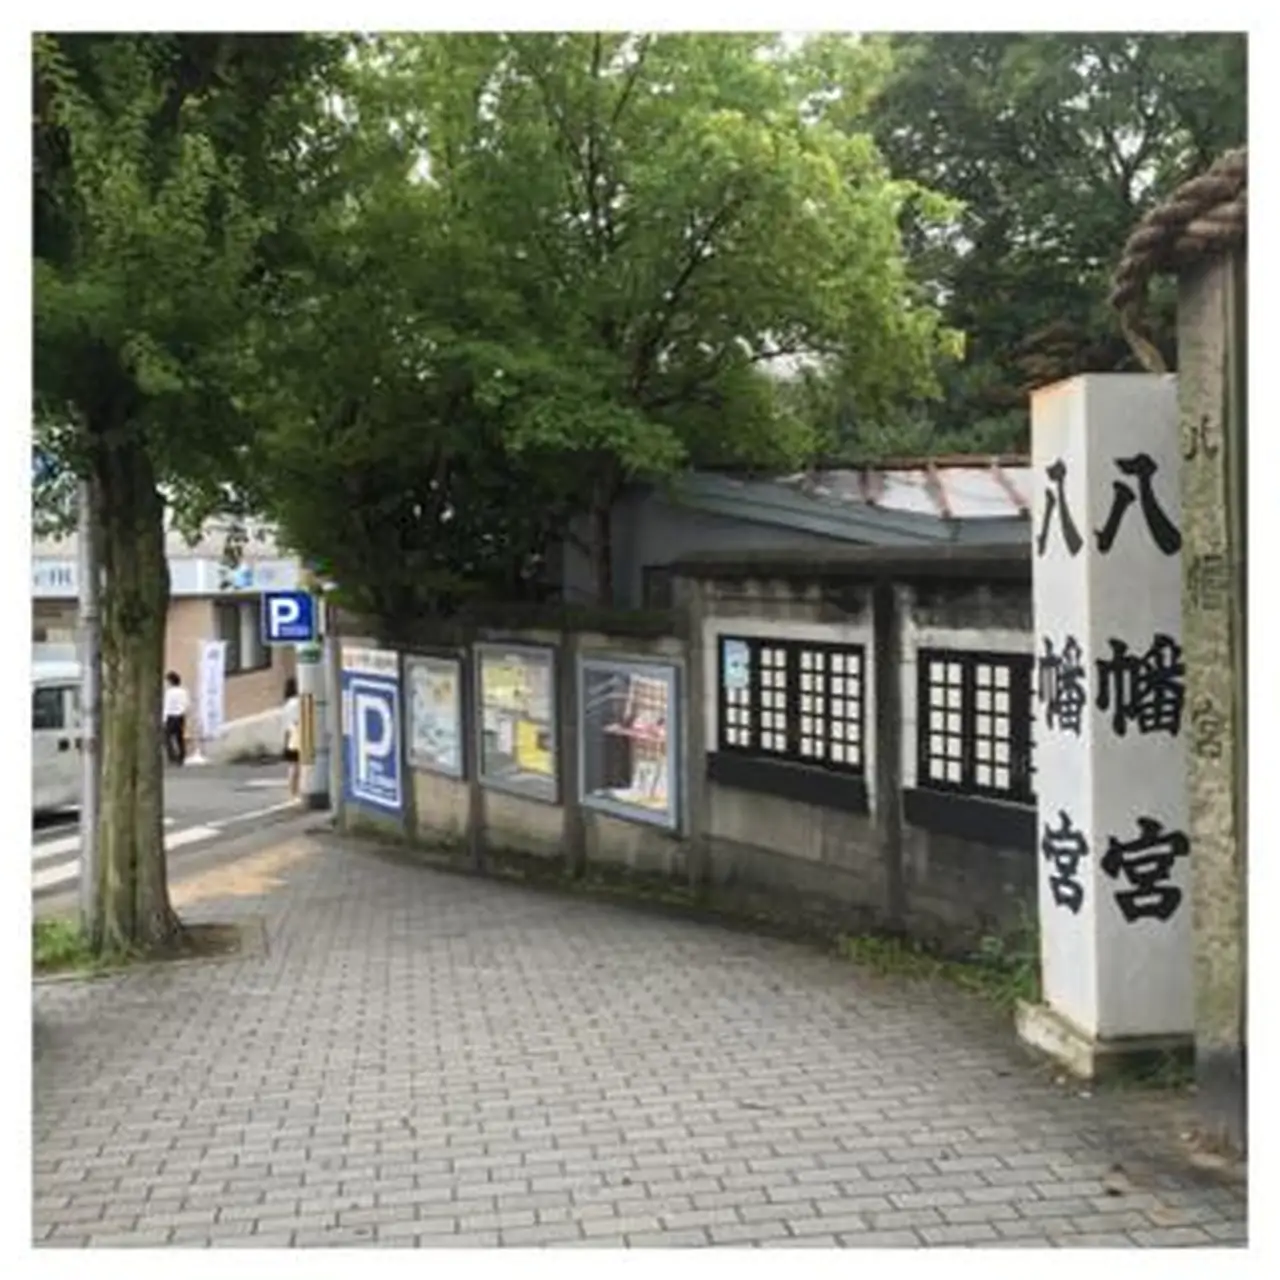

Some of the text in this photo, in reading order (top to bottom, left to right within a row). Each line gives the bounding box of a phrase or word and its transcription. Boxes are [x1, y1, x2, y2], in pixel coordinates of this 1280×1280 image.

[270, 597, 301, 638] P
[353, 692, 394, 783] P
[1036, 457, 1091, 916] 八幡宮
[1094, 451, 1192, 923] 八幡宮
